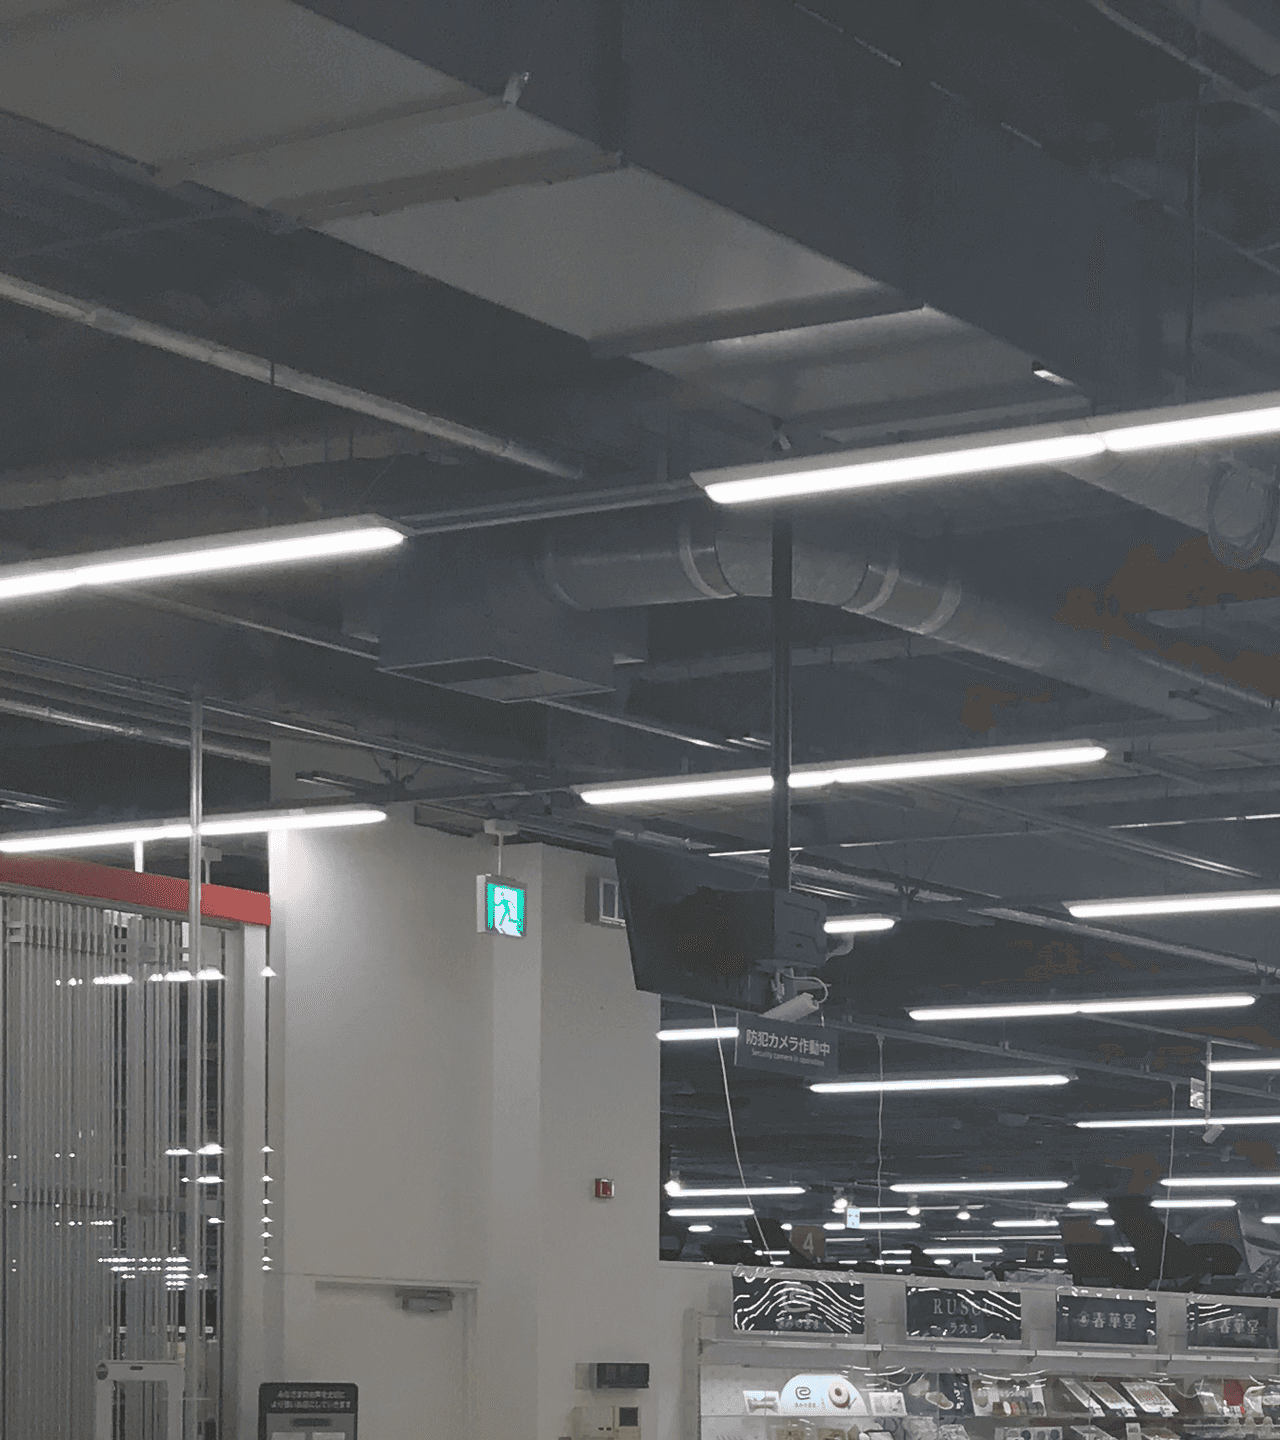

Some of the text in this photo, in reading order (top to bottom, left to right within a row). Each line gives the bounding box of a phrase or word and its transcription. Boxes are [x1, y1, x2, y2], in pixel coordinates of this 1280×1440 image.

[746, 1029, 830, 1057] 防犯カメラ作動中
